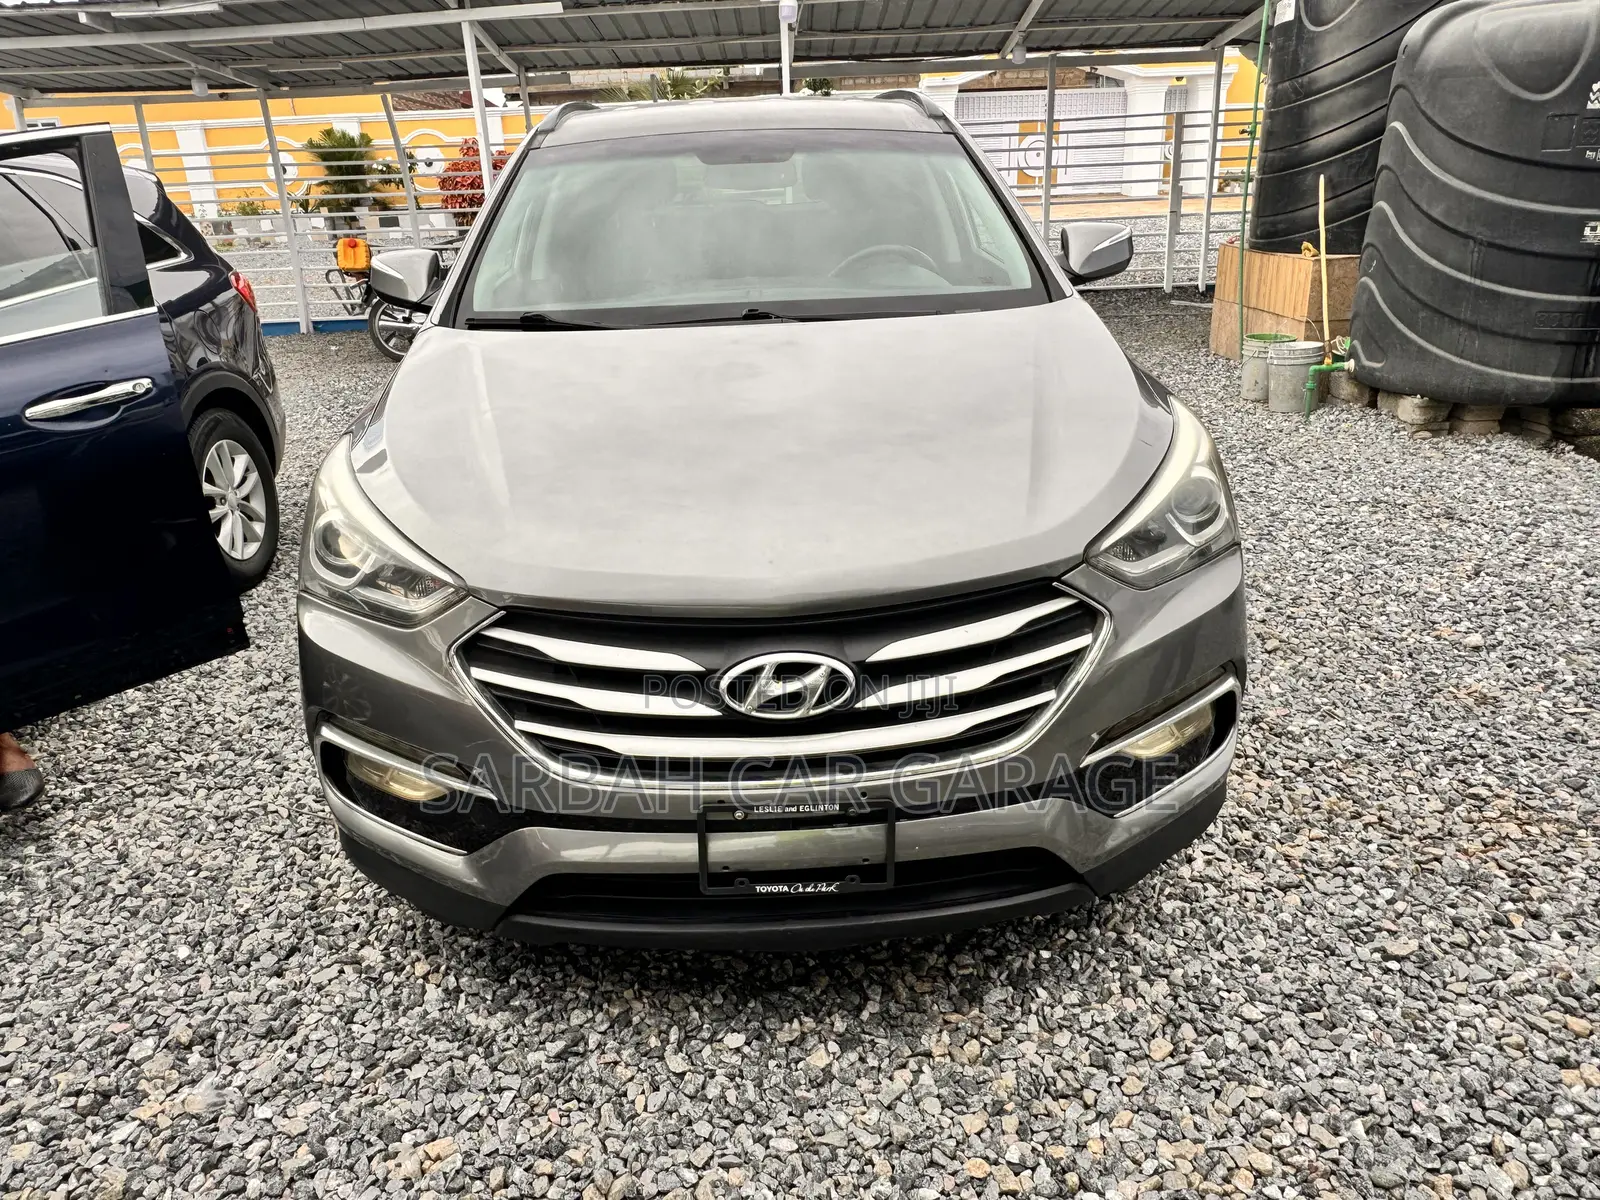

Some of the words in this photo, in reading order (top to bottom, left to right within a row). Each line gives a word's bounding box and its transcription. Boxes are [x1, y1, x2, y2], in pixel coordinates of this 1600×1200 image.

[754, 805, 783, 813] LESLIE
[800, 804, 839, 812] EGLINTON
[755, 885, 789, 893] TOYOTA
